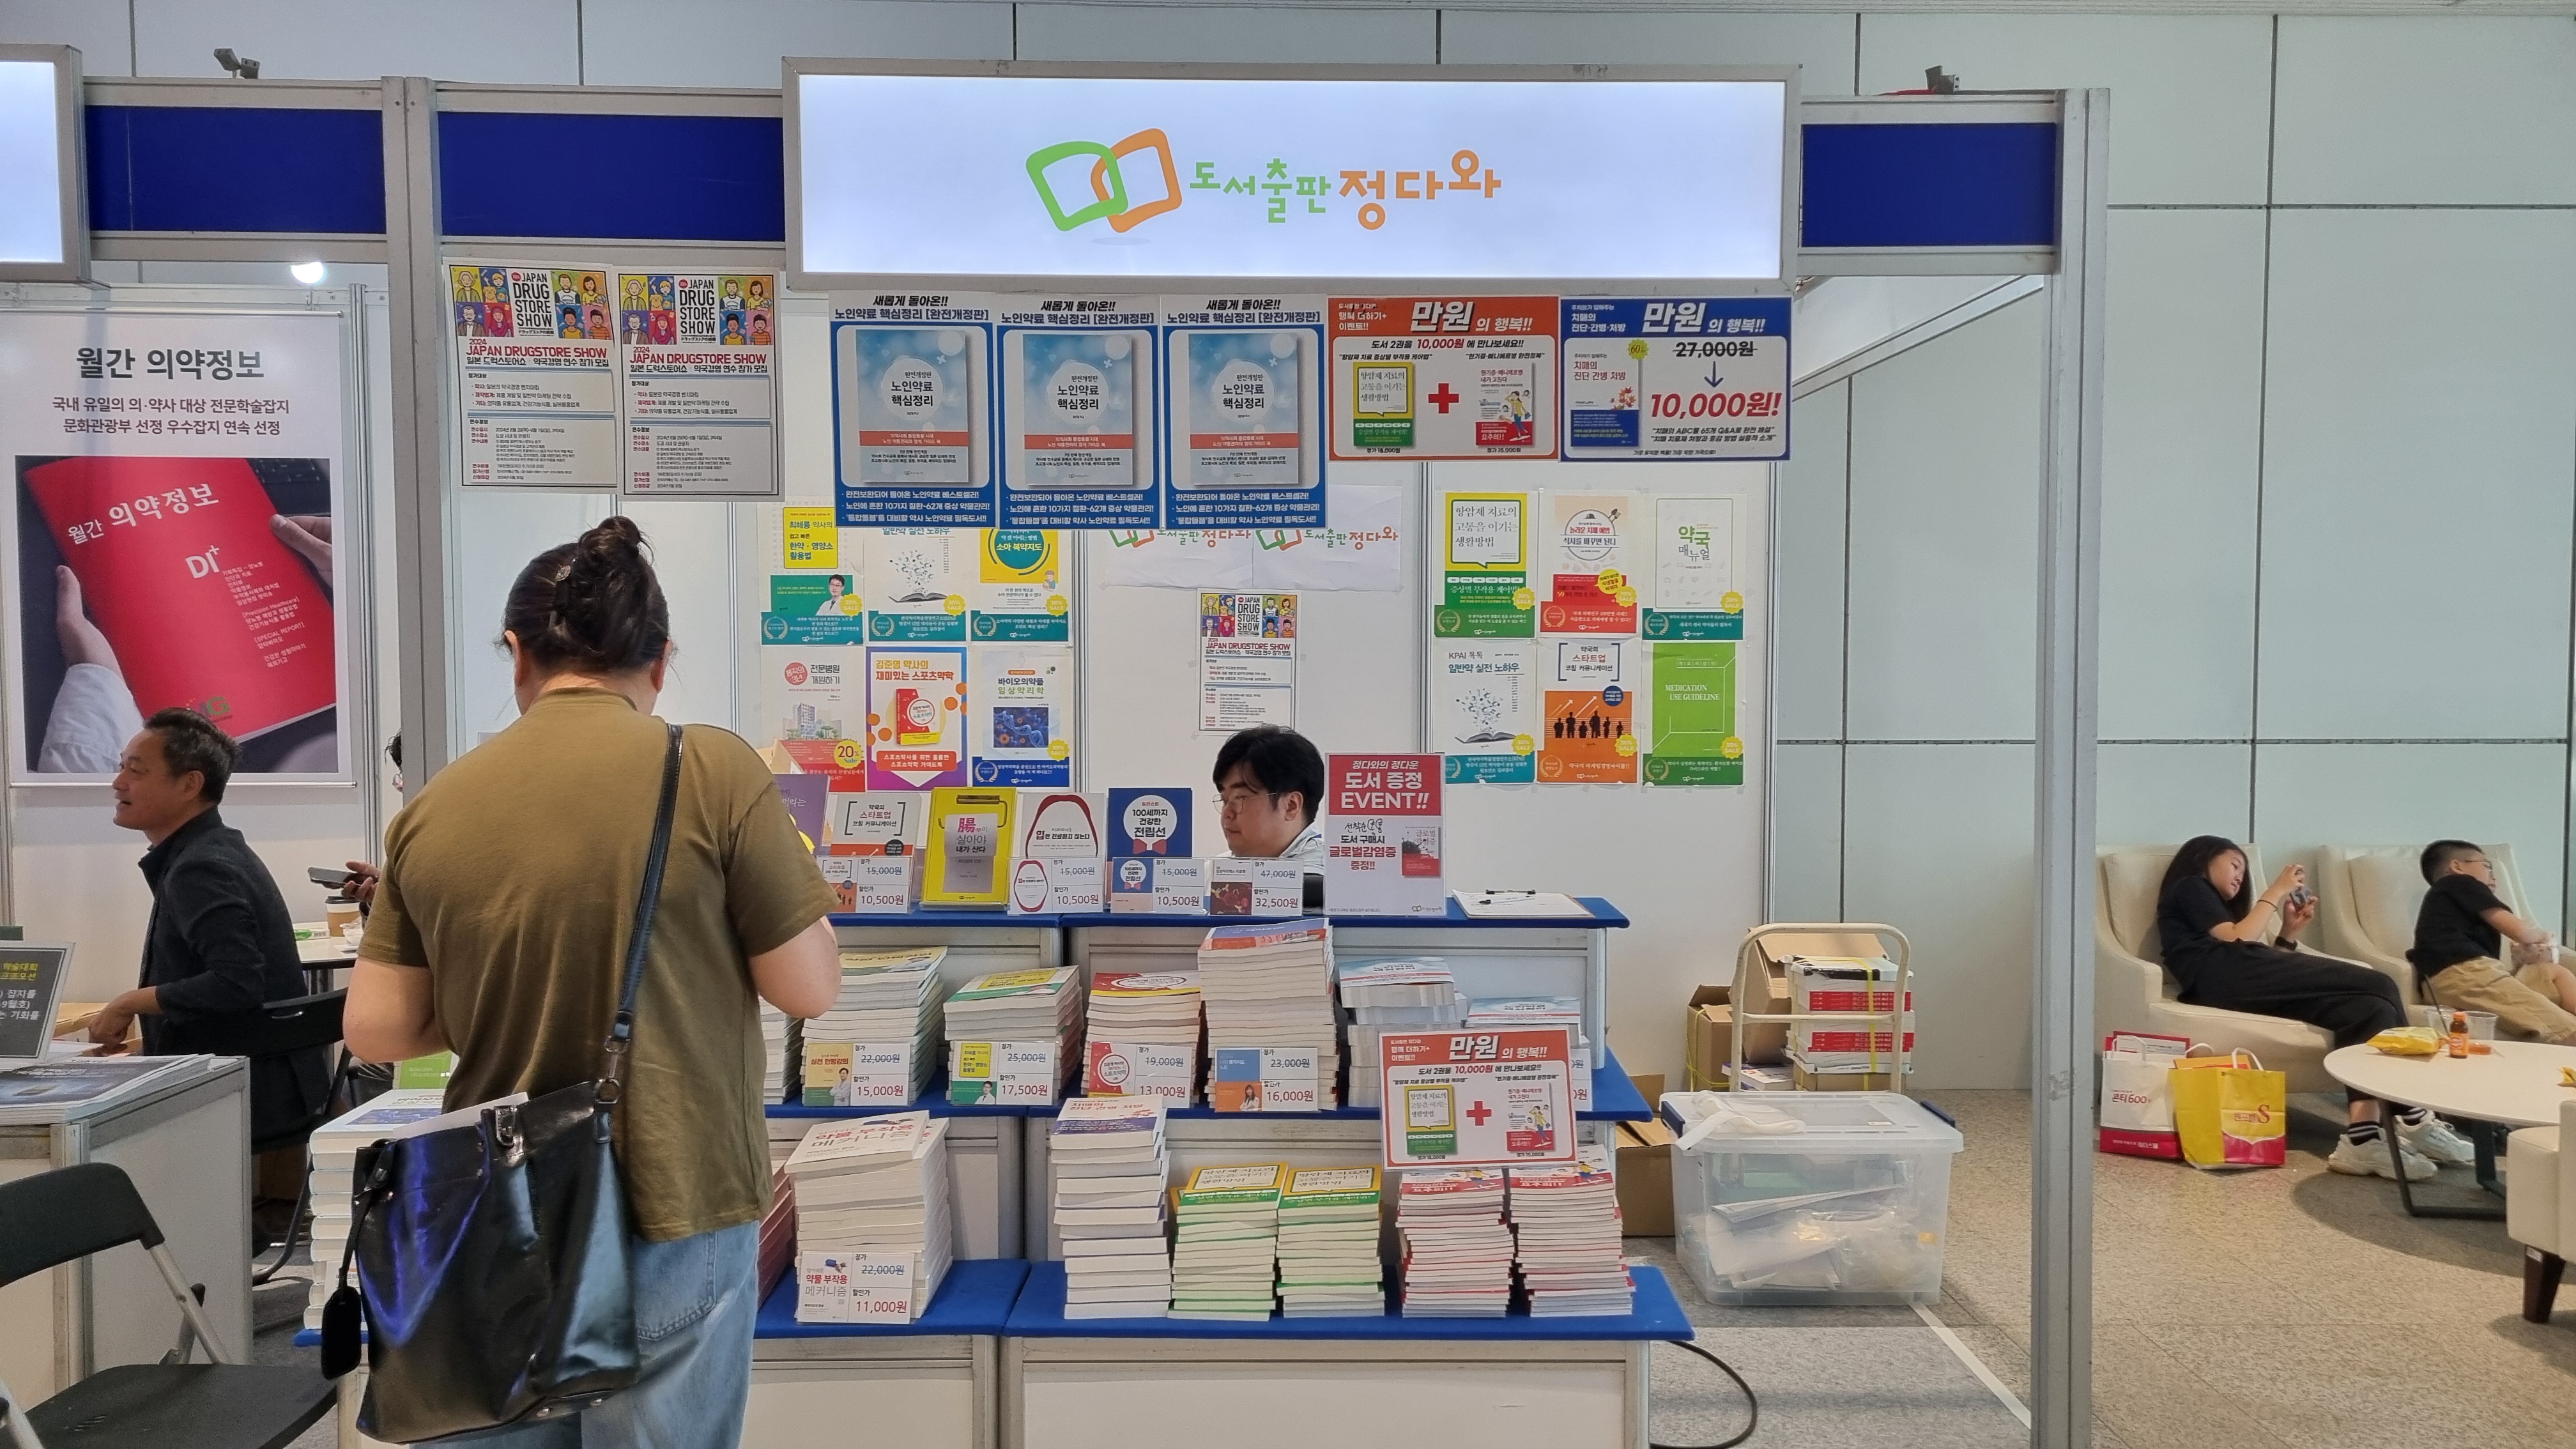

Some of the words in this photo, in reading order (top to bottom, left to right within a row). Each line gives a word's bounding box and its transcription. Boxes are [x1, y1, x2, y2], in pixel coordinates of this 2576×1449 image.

[1190, 158, 1331, 223] 도서출판
[1338, 150, 1502, 230] 정다와
[521, 273, 548, 282] JAPAN
[689, 279, 714, 288] JAPAN
[513, 283, 549, 299] DRUG
[680, 290, 714, 306] DRUG
[873, 295, 906, 306] 새롭게
[908, 296, 948, 306] 돌아온!!
[515, 300, 552, 314] STORE
[1040, 301, 1073, 311] 새롭게
[1077, 301, 1116, 311] 돌아온!!
[1206, 300, 1239, 310] 새롭게
[1241, 300, 1280, 310] 돌아온!!
[680, 307, 715, 320] STORE
[834, 309, 877, 319] 노인약료
[880, 309, 923, 320] 핵심정리
[926, 309, 988, 320] [완전개정판]
[1410, 301, 1474, 332] 만원
[1475, 319, 1490, 331] 의
[1494, 318, 1532, 332] 행복!!
[1642, 303, 1706, 333] 만원
[1708, 320, 1721, 333] 의
[1728, 319, 1765, 333] 행복!!
[517, 314, 552, 327] SHOW
[1001, 314, 1044, 323] 노인약료
[1047, 314, 1090, 324] 핵심정리
[1093, 314, 1154, 325] [완전개정판]
[680, 321, 715, 334] SHOW
[1371, 341, 1388, 349] 도서
[1390, 341, 1412, 349] 2권을
[1417, 339, 1464, 349] 10,000원
[1477, 339, 1524, 349] 만나보세요!!
[1676, 341, 1754, 357] 27,000원
[466, 346, 502, 356] JAPAN
[505, 346, 571, 357] DRUGSTORE
[574, 347, 607, 358] SHOW
[76, 348, 135, 378] 월간
[147, 349, 264, 380] 의약정보
[483, 357, 526, 365] 드럭스토어쇼
[579, 358, 594, 367] 참가
[595, 358, 609, 367] 모집
[630, 354, 663, 364] JAPAN
[667, 354, 731, 364] DRUGSTORE
[734, 354, 767, 364] SHOW
[1574, 361, 1597, 369] 치매의
[1574, 372, 1590, 380] 진단
[1592, 372, 1607, 380] 간병
[1611, 372, 1625, 380] 처방
[891, 381, 933, 392] 노인약료
[52, 397, 79, 411] 국내
[83, 397, 124, 412] 유일의
[180, 399, 206, 413] 대상
[210, 399, 289, 414] 전문학술잡지
[891, 395, 933, 406] 핵심정리
[1057, 399, 1099, 410] 핵심정리
[1651, 393, 1782, 419] 10,000원!
[64, 418, 132, 433] 문화관광부
[136, 420, 162, 434] 선정
[167, 420, 220, 434] 우수잡지
[224, 420, 250, 434] 연속
[254, 420, 280, 435] 선정
[67, 520, 105, 545] 월간
[109, 483, 220, 529] 의약정보
[1455, 507, 1485, 518] 항암제
[1487, 507, 1517, 517] 치료의
[1455, 522, 1485, 532] 고통을
[1489, 522, 1517, 532] 이기는
[1455, 537, 1494, 548] 생활방법
[1678, 526, 1710, 549] 약국
[1678, 544, 1710, 562] 매뉴얼
[1238, 604, 1260, 613] DRUG
[1572, 654, 1606, 663] 스타트업
[1448, 664, 1474, 673] 일반약
[1476, 664, 1492, 673] 실전
[1494, 663, 1519, 672] 노하우
[811, 676, 839, 684] 개원하기
[876, 671, 909, 680] 재미있는
[912, 671, 954, 680] 스포츠약학
[1353, 761, 1388, 769] 정다와의
[1392, 761, 1418, 770] 정다운
[1346, 772, 1381, 788] 도서
[1386, 772, 1422, 789] 증정
[1342, 793, 1429, 809] EVENT!!
[1134, 827, 1165, 838] 전립선
[956, 835, 986, 845] 살아야
[1330, 847, 1396, 857] 글로벌감염증
[1351, 861, 1375, 870] 증정!!
[1261, 870, 1296, 878] 47,000원
[861, 895, 903, 905] 10,500원
[1057, 894, 1099, 905] 10,500원
[1158, 896, 1199, 906] 10,500원
[1255, 898, 1298, 908] 32,500원
[1448, 1035, 1499, 1060] 만원
[1502, 1049, 1512, 1059] 의
[1517, 1046, 1547, 1059] 행복!!
[861, 1054, 900, 1063] 22,000원
[1008, 1053, 1046, 1062] 25,000원
[1146, 1057, 1183, 1067] 19,000원
[1270, 1059, 1310, 1068] 23,000원
[857, 1085, 903, 1096] 15,000원
[1002, 1085, 1048, 1096] 17,500원
[1267, 1091, 1313, 1101] 16,000원
[862, 1265, 905, 1275] 22,000원
[806, 1275, 822, 1284] 약물
[824, 1275, 848, 1284] 부작용
[805, 1285, 847, 1297] 메커니즘
[856, 1301, 907, 1314] 11,000원
